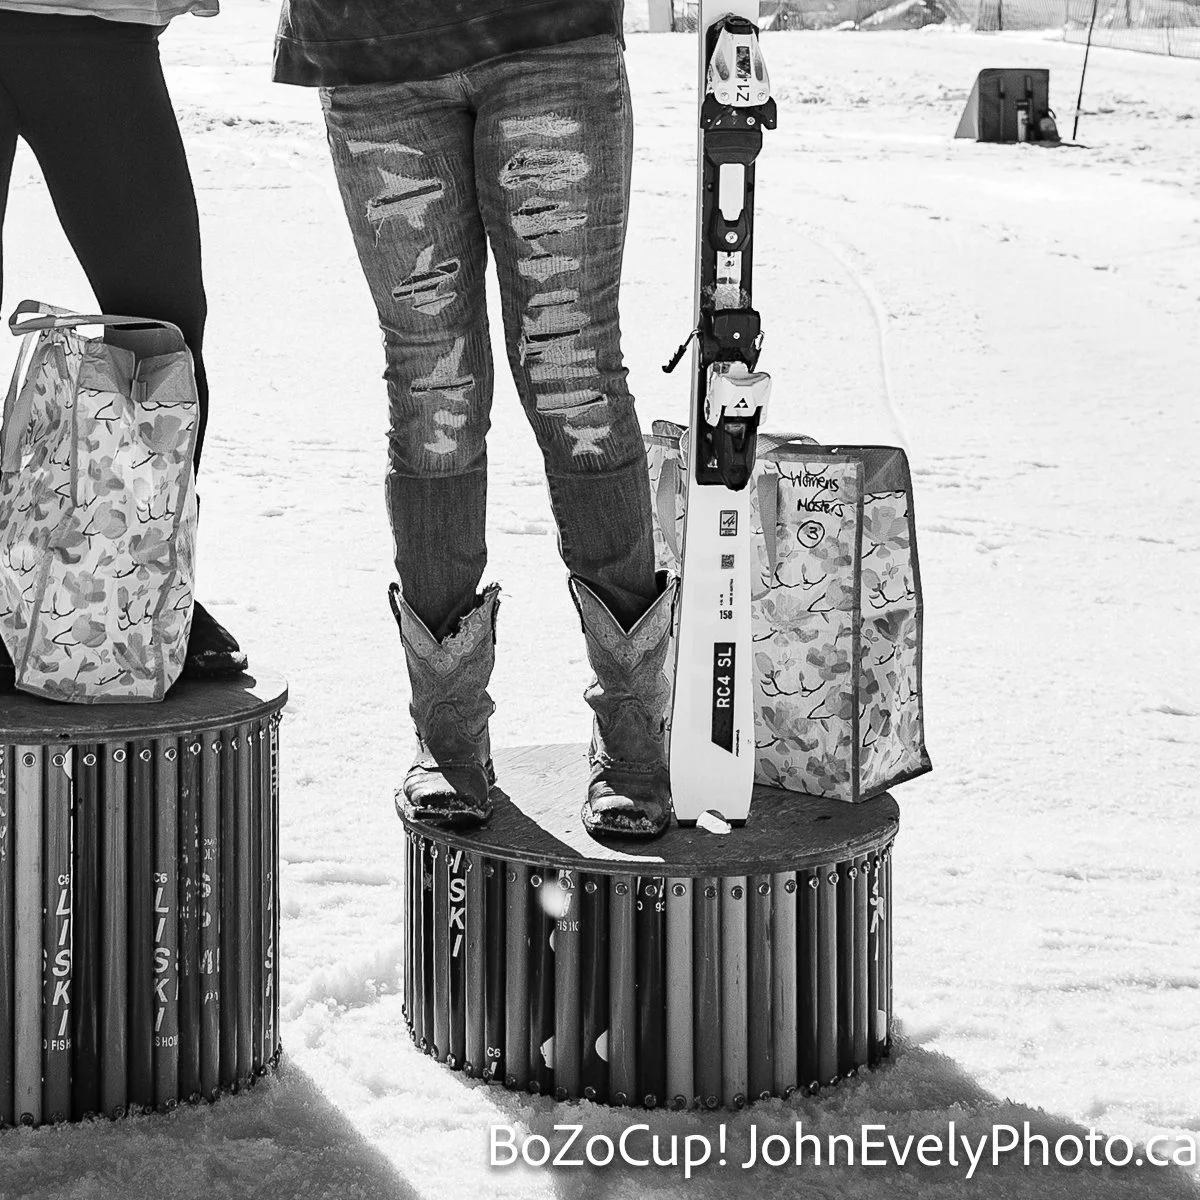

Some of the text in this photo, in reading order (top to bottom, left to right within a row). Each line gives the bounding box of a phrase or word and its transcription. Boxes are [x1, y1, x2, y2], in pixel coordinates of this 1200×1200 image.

[719, 609, 733, 620] 158
[716, 647, 732, 708] RC4 SL
